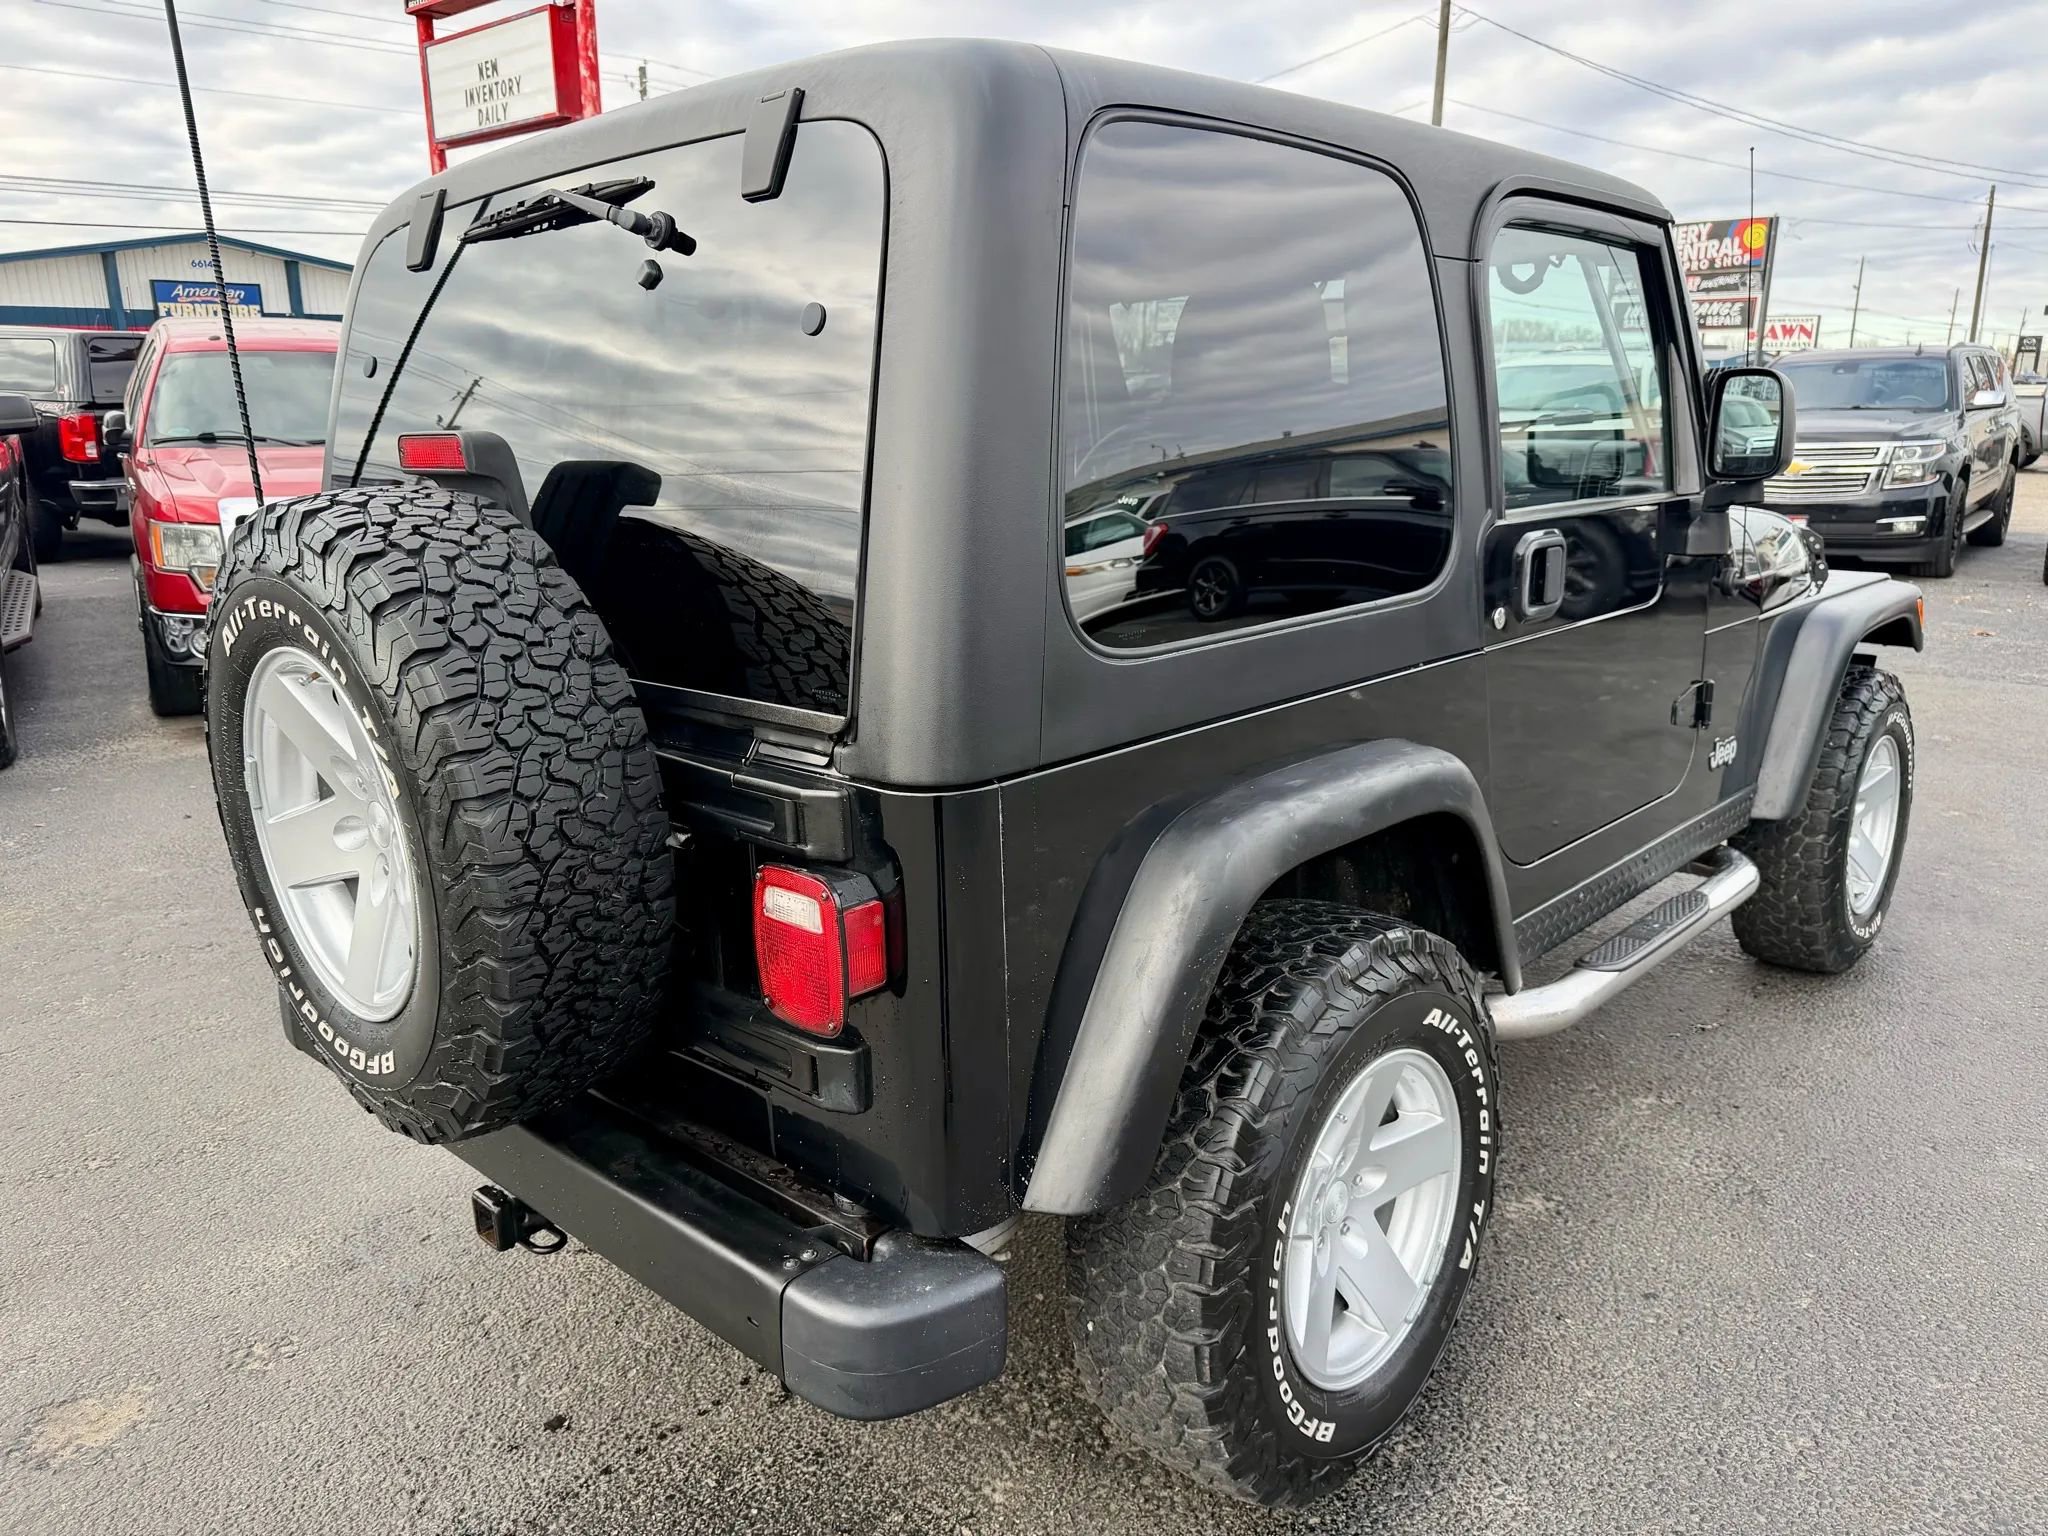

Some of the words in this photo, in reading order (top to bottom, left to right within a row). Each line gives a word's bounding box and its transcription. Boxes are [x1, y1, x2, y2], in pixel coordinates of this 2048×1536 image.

[477, 58, 499, 81] NEW
[464, 75, 522, 108] INVENTORY
[477, 102, 509, 127] DAILY
[171, 284, 245, 300] Amerian
[221, 595, 347, 685] All-Terrain
[1709, 736, 1737, 769] Jeep
[1422, 1007, 1490, 1175] All-Terrain
[1457, 1199, 1486, 1271] T/A
